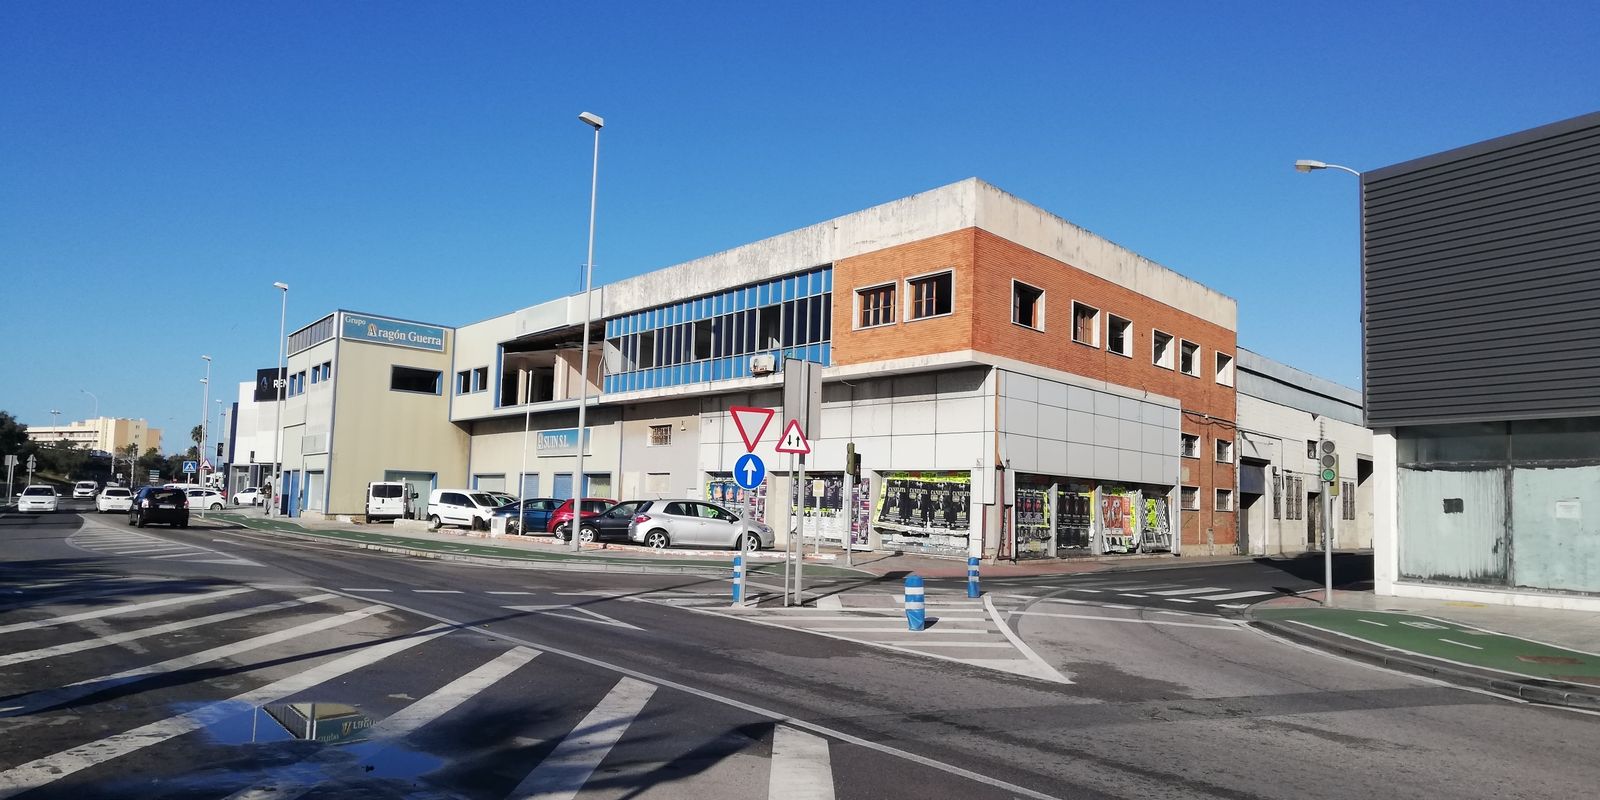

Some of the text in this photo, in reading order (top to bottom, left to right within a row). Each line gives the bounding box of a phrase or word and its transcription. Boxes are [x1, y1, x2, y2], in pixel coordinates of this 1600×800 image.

[345, 315, 366, 326] Grupo
[367, 323, 441, 346] Aragón Guerra
